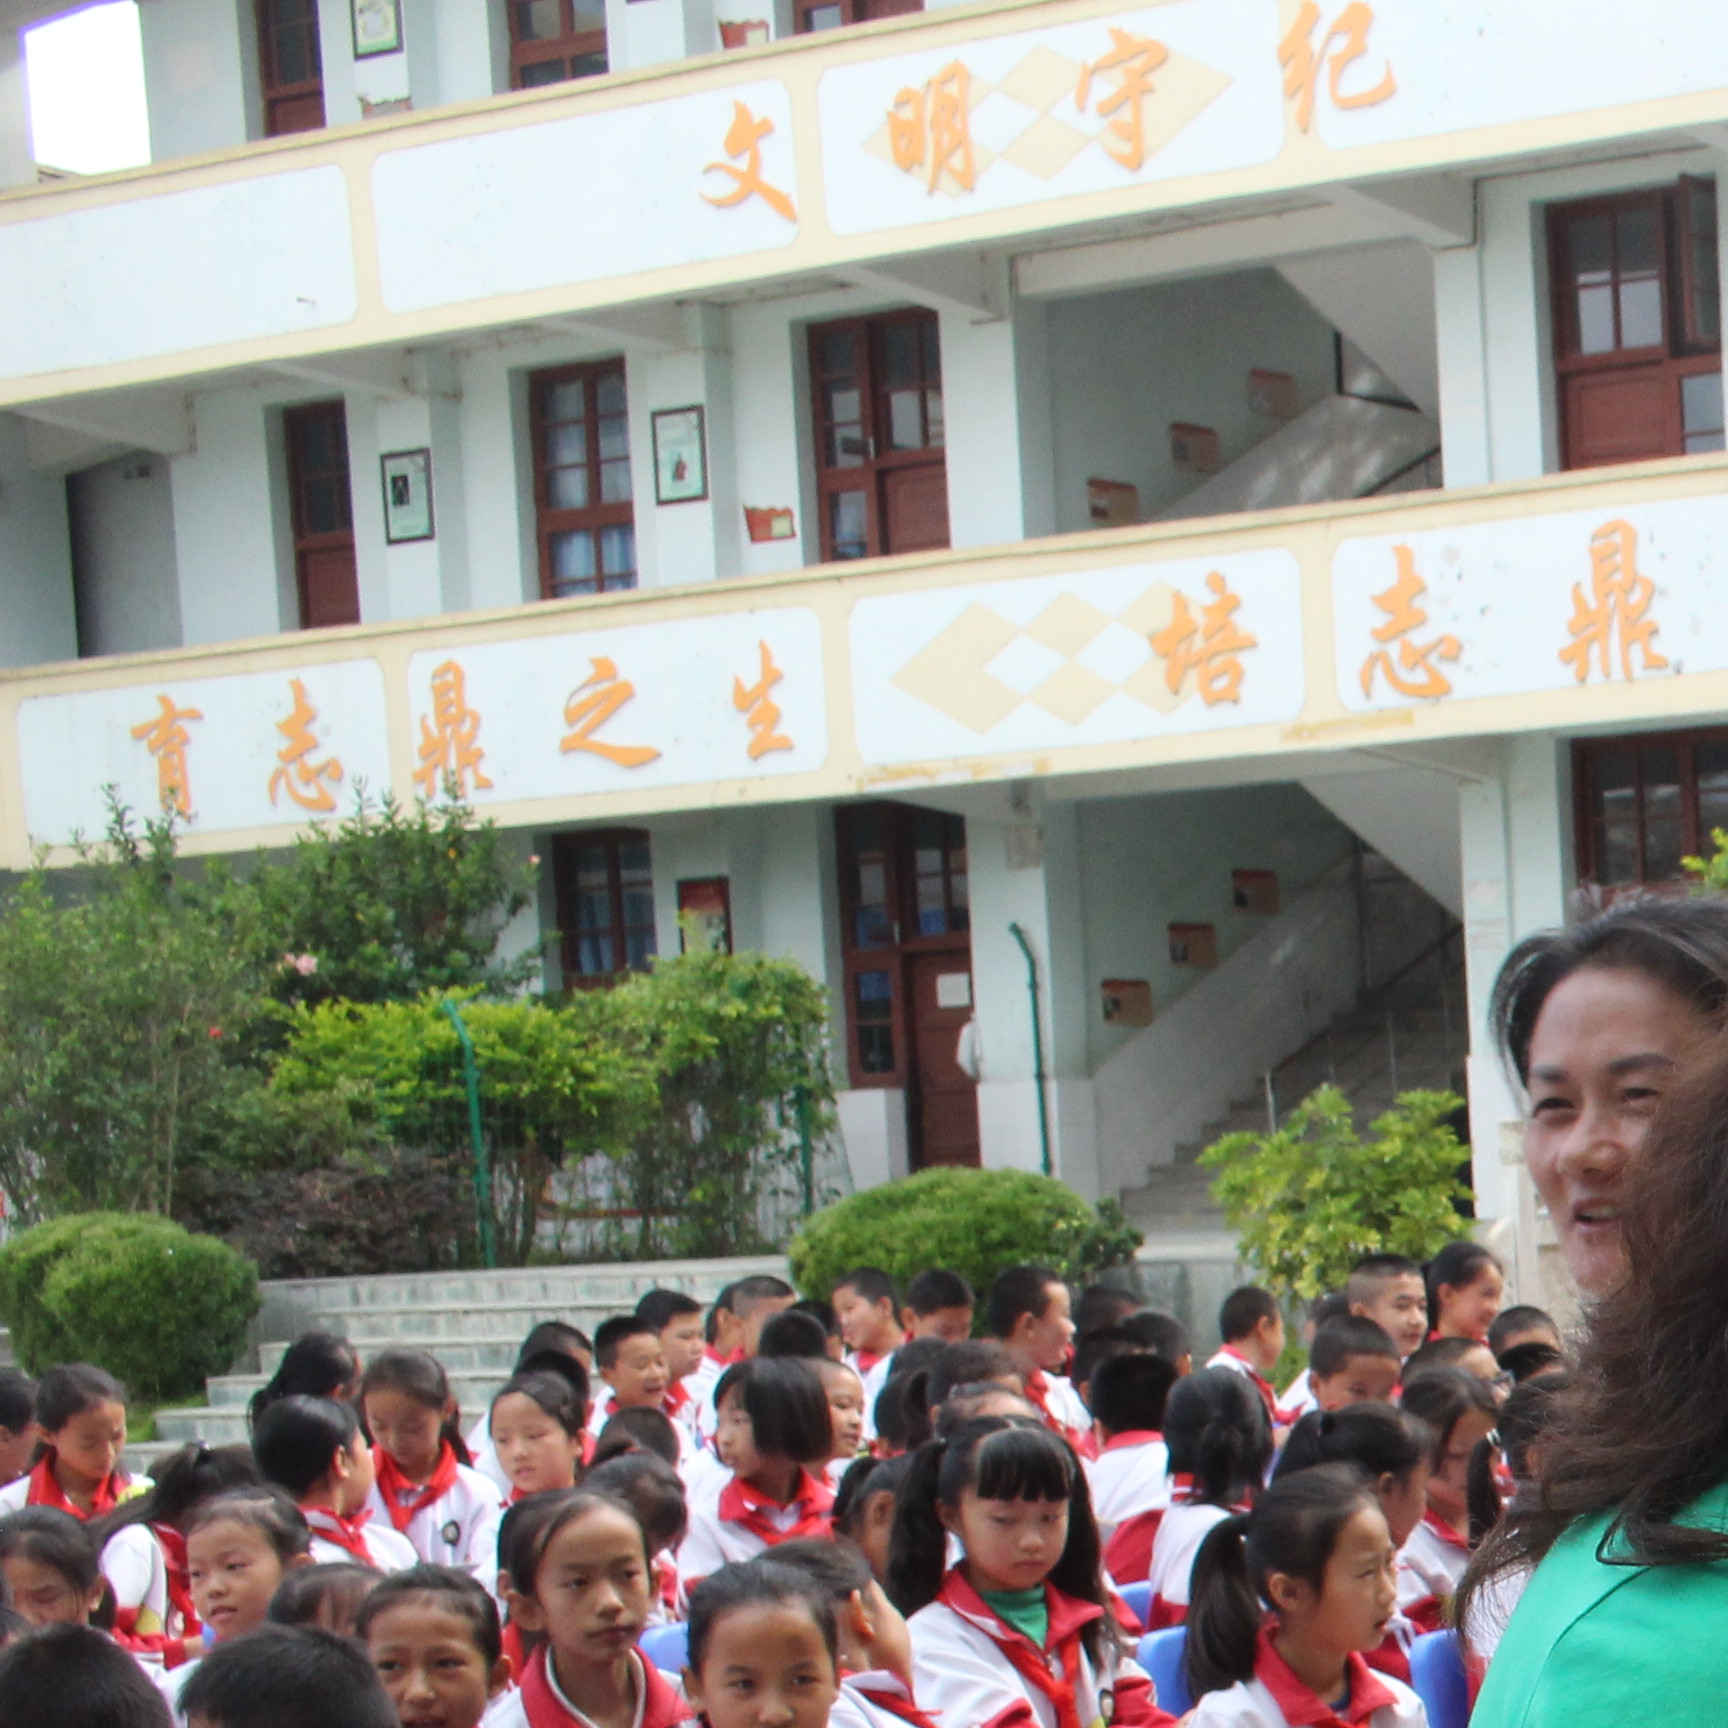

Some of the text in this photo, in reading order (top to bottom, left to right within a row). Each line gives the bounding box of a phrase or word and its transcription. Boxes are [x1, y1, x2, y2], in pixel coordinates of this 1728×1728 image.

[699, 0, 1398, 224] 文明守纪
[131, 639, 796, 822] 育志鼎之生
